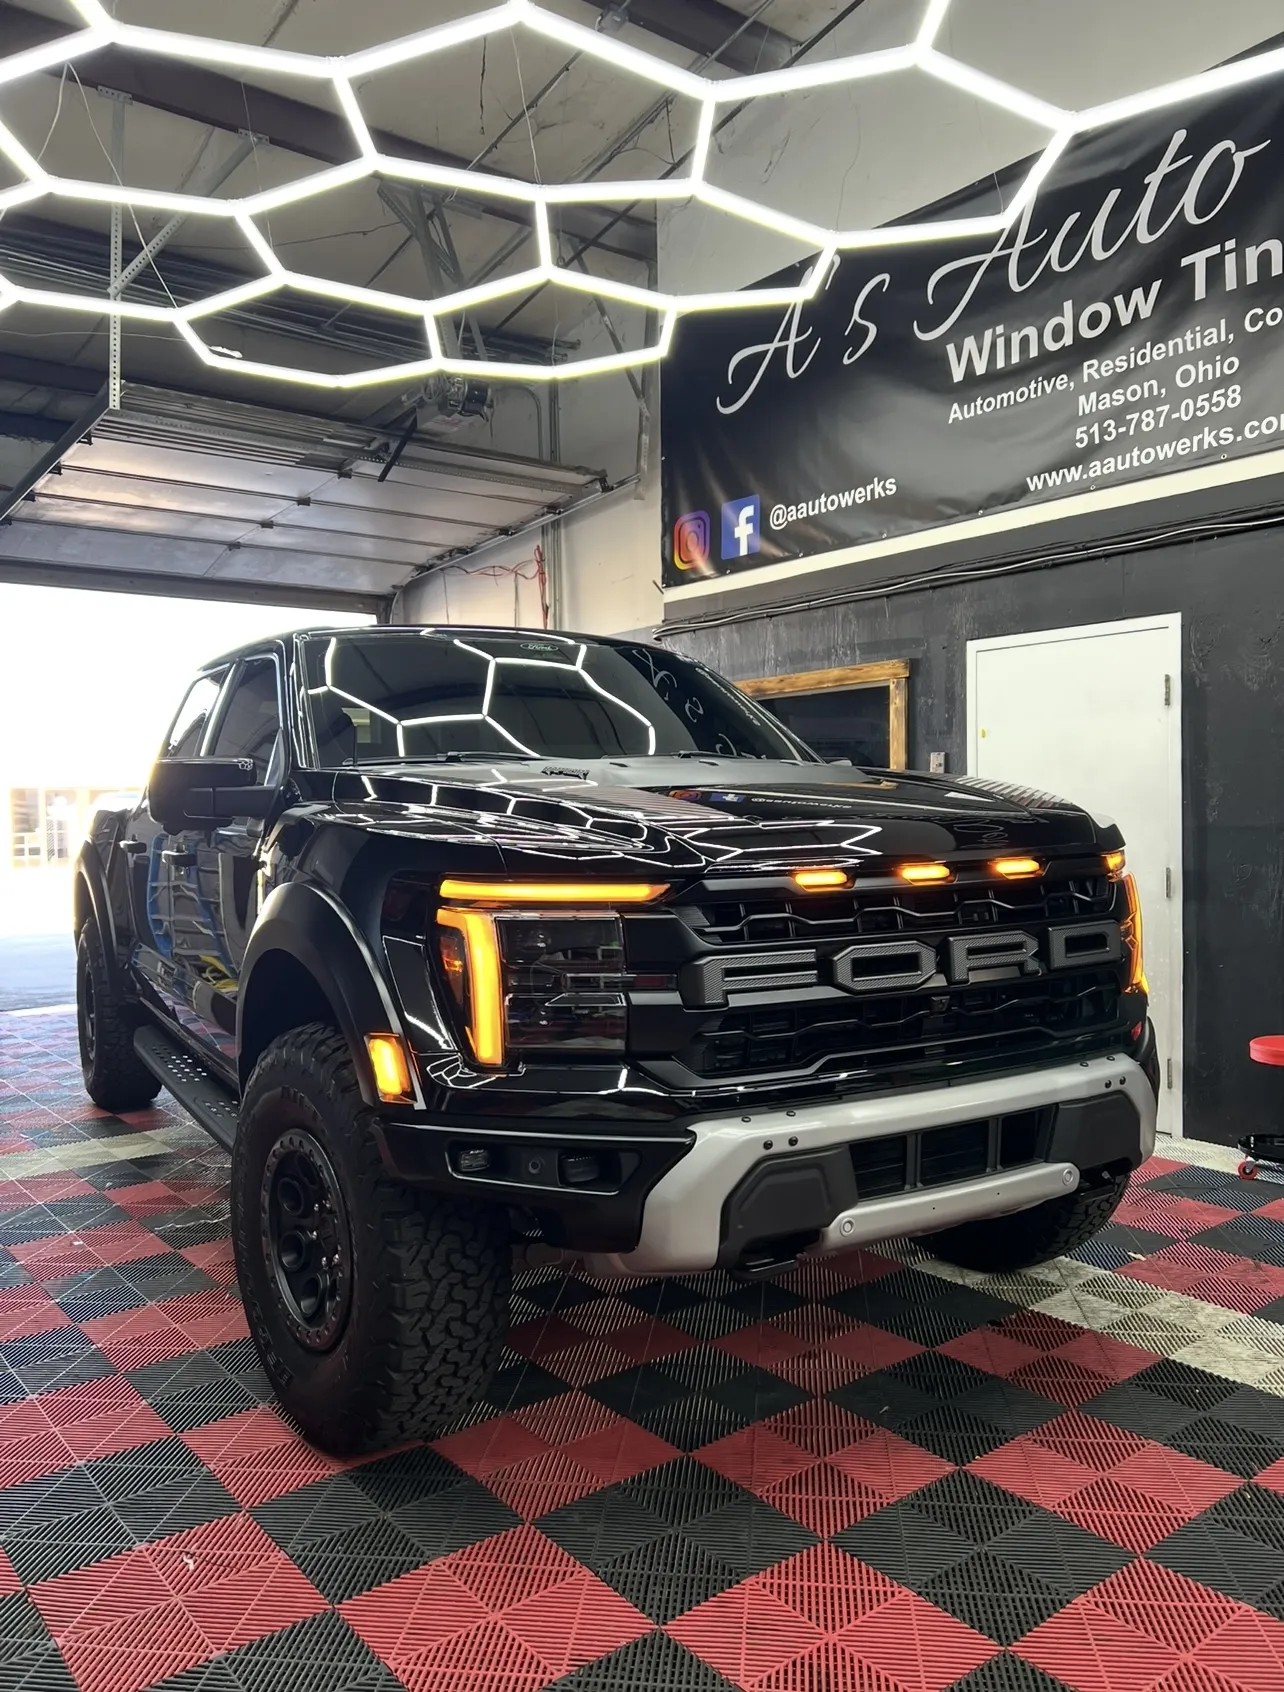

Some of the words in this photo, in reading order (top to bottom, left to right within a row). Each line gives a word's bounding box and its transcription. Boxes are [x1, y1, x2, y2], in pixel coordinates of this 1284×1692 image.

[913, 129, 1271, 341] Auto
[946, 279, 1163, 383] Window
[1180, 238, 1283, 301] Tin
[948, 373, 1075, 424] Automotive,
[1082, 318, 1235, 383] Residential,
[1244, 307, 1283, 333] Co
[1077, 378, 1167, 416] Mason,
[1175, 355, 1240, 388] Ohio
[1025, 413, 1284, 492] www.aautowerks.co
[1074, 384, 1242, 449] 513-787-0558
[769, 476, 897, 530] @aautowerks
[701, 920, 1123, 1005] FORD
